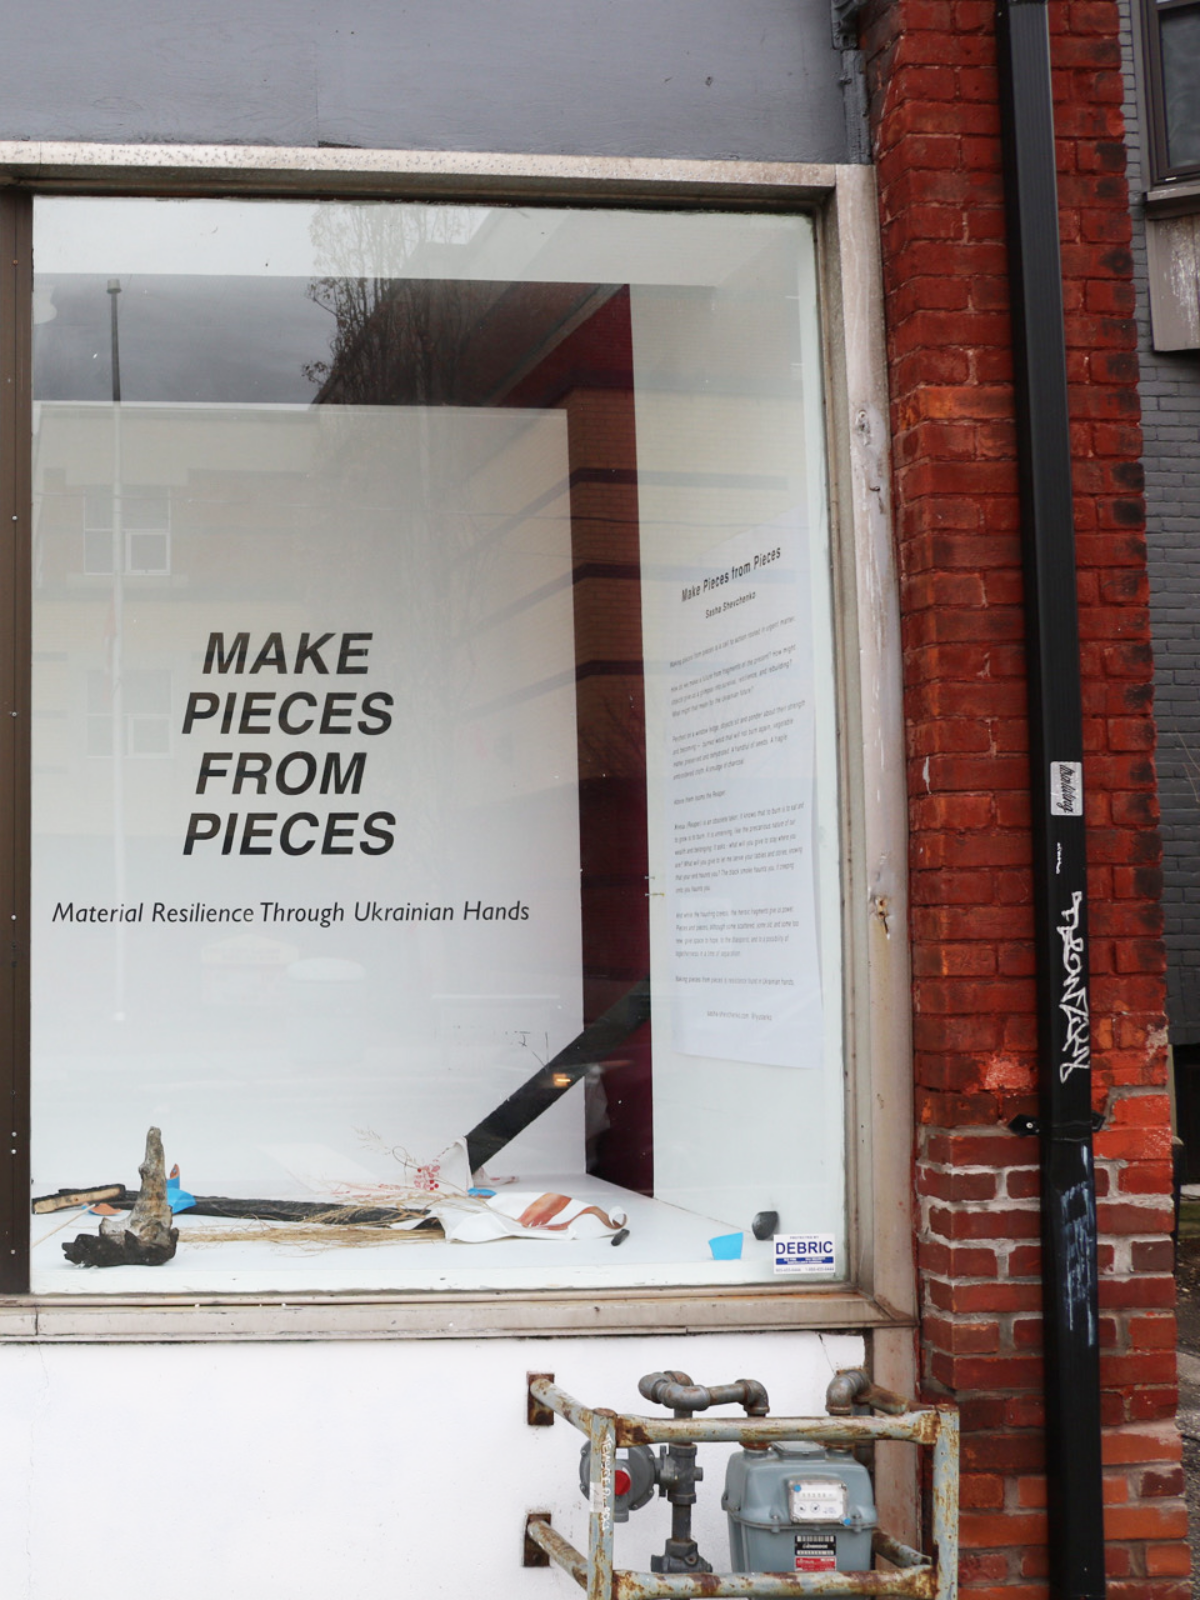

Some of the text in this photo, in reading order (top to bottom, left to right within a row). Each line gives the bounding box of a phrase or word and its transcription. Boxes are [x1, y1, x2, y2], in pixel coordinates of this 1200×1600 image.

[681, 547, 781, 602] Make Pieces from Pieces
[705, 591, 756, 619] Sasha Shevchenko
[202, 632, 373, 674] MAKE
[182, 691, 394, 735] PIECES
[195, 751, 368, 795] FROM
[183, 811, 396, 856] PIECES
[52, 901, 530, 928] Material Resilience Through Ukrainian Hands
[775, 1241, 833, 1255] DEBRIC
